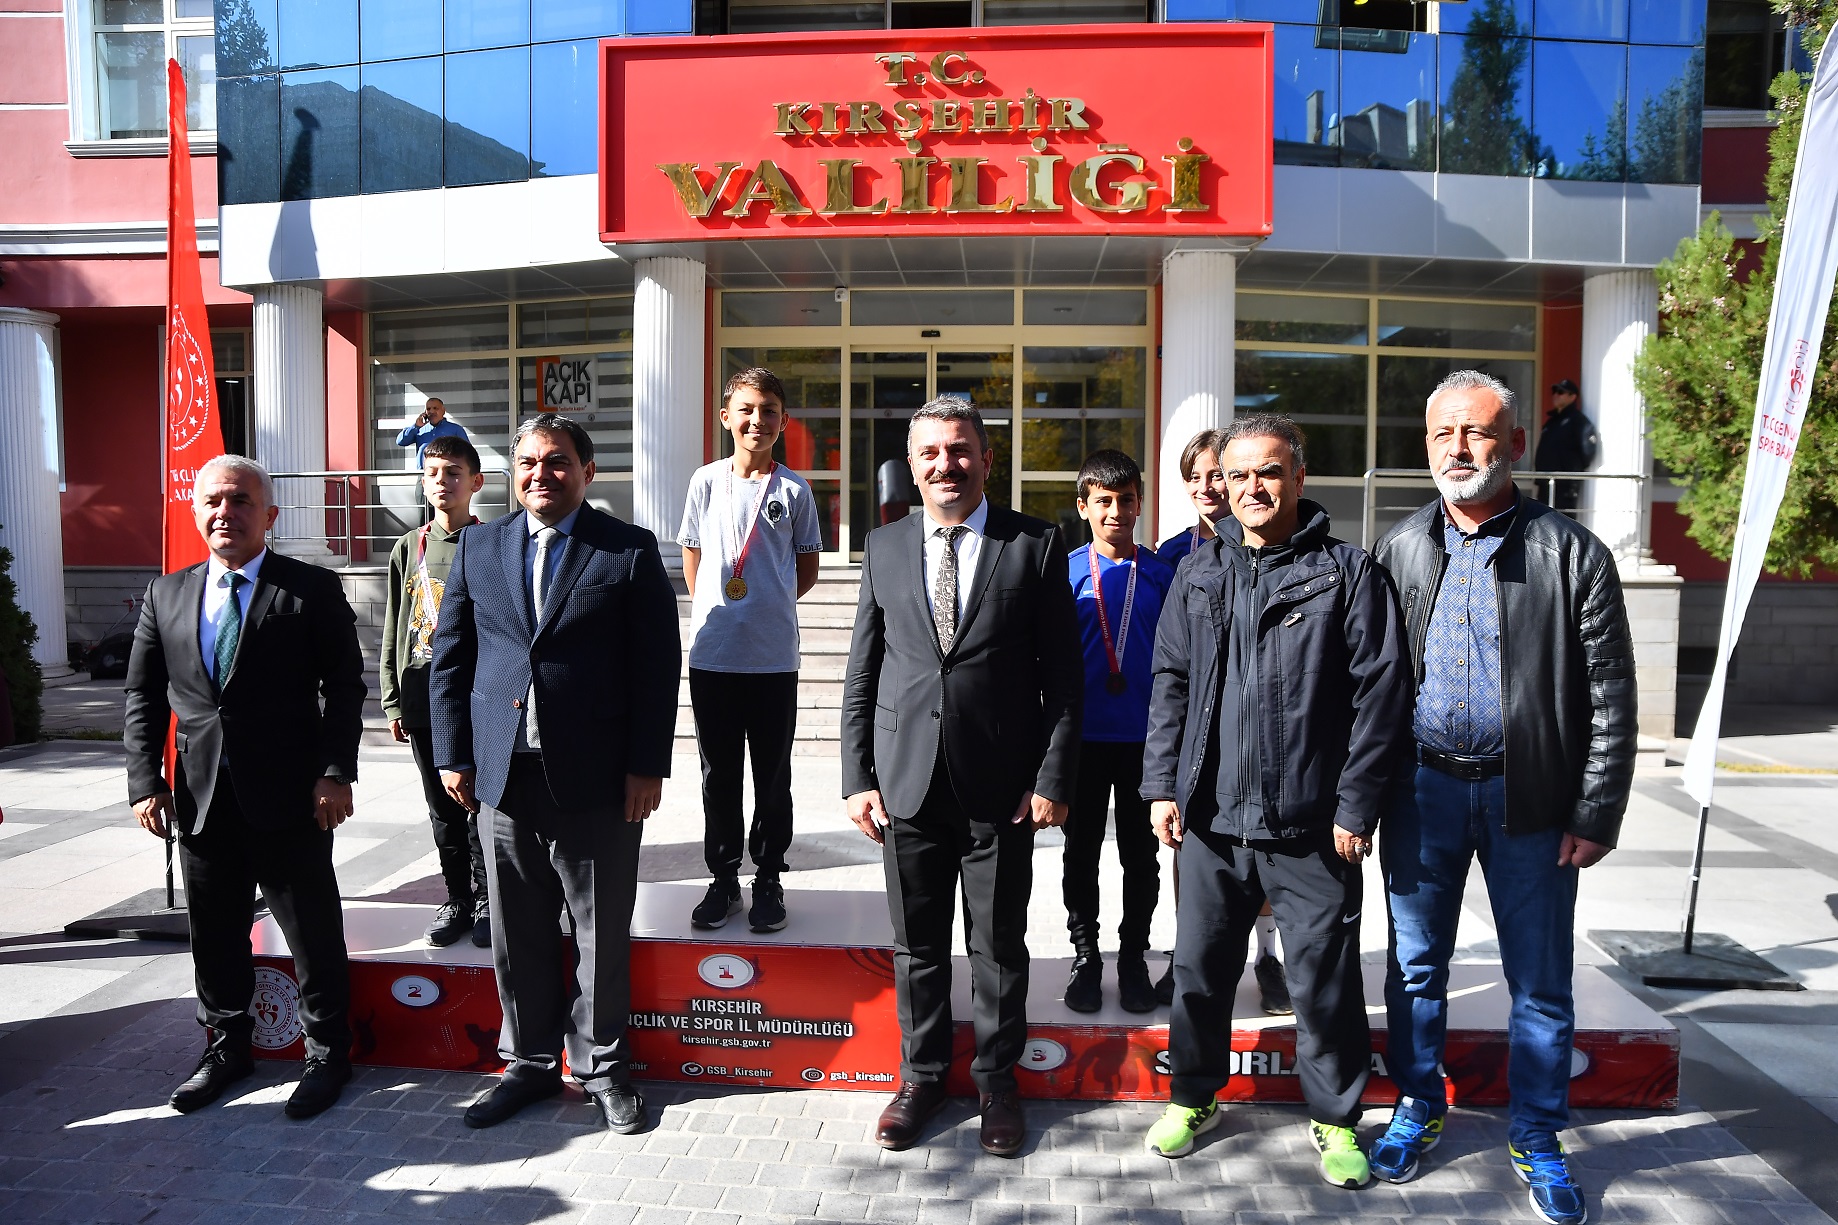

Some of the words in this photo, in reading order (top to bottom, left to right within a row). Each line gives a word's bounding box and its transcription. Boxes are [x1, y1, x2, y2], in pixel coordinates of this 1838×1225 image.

[874, 50, 985, 86] T.C.
[772, 87, 1090, 140] KIRŞEHİR
[655, 136, 1211, 219] VALİLİĞİ
[544, 361, 591, 384] AÇIK
[544, 382, 591, 405] KAPI
[719, 964, 734, 979] 1
[407, 985, 422, 998] 2
[691, 998, 762, 1015] KIRŞEHİR
[670, 1015, 689, 1029] VE
[693, 1017, 734, 1032] SPOR
[738, 1017, 753, 1033] İL
[757, 1019, 854, 1038] MÜDÜRLÜĞÜ
[682, 1034, 772, 1049] kirsehir.gsb.gov.tr
[1031, 1046, 1047, 1062] 3
[706, 1065, 774, 1078] GSB_Kirsehir
[829, 1070, 895, 1083] gsb_kirsehir
